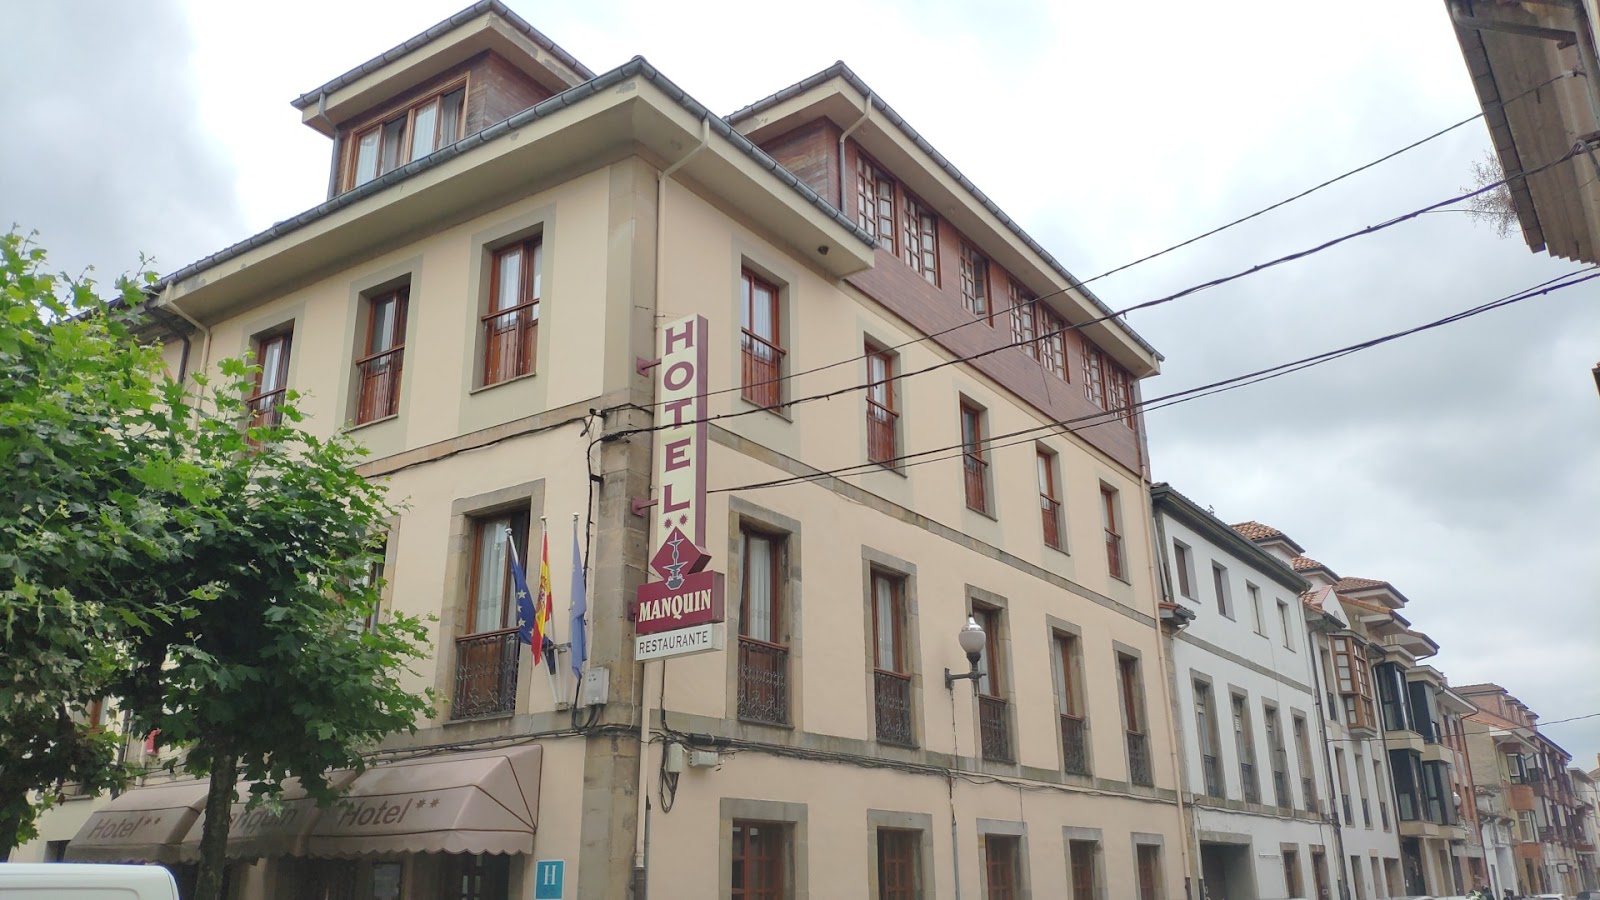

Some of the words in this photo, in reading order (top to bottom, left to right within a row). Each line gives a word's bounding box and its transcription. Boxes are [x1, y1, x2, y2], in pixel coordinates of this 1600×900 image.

[664, 320, 694, 515] HOTEL
[638, 588, 712, 622] MANQUIN
[638, 630, 708, 655] RESTAURANTE
[338, 798, 413, 828] Hotel
[87, 815, 144, 840] Hotel
[543, 864, 557, 886] H
